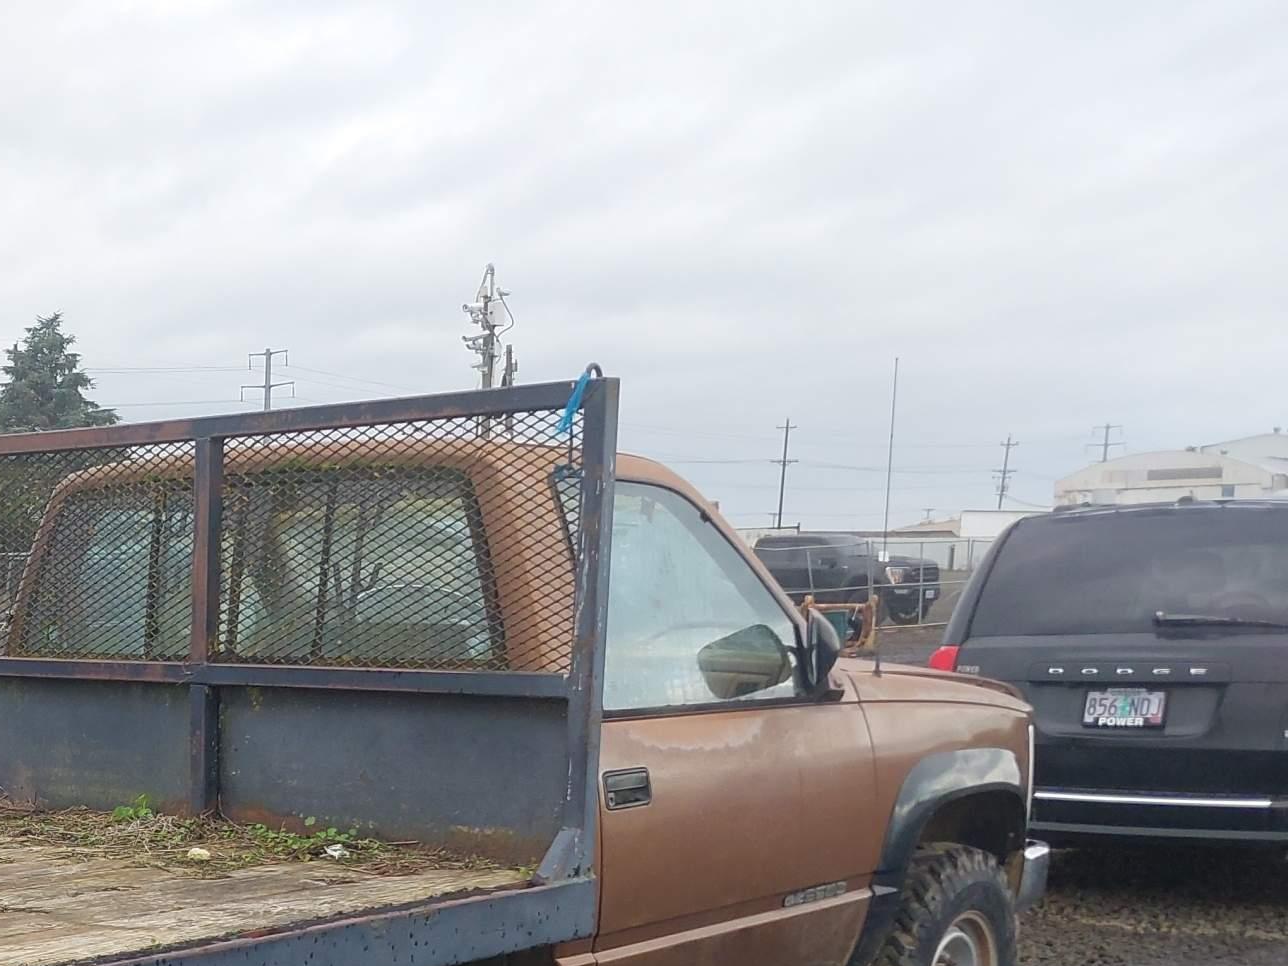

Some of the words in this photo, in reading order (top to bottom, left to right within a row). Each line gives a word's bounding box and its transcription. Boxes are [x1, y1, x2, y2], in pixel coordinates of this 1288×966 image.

[1048, 667, 1209, 676] DODGE
[1086, 697, 1118, 716] 856
[1098, 717, 1143, 726] POWER
